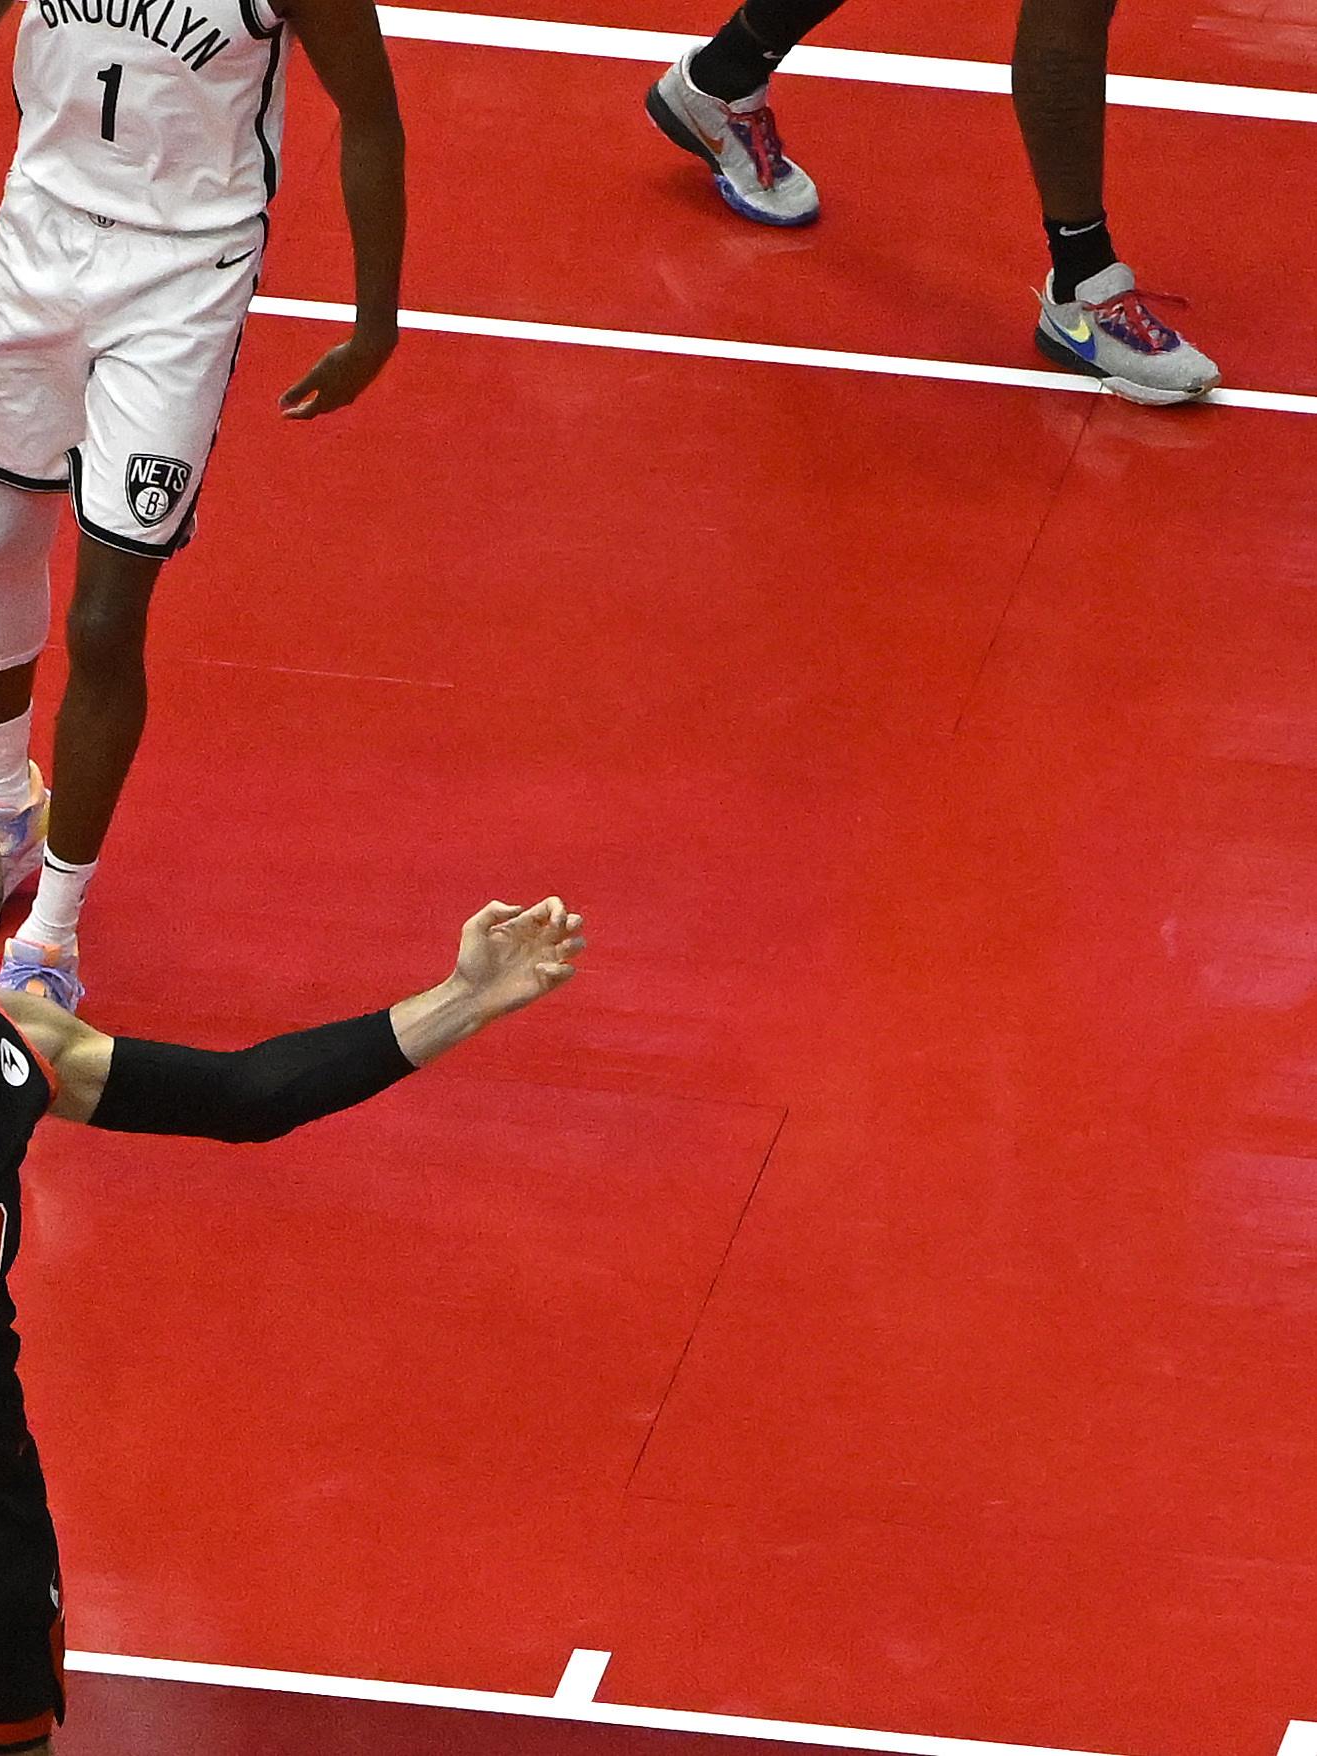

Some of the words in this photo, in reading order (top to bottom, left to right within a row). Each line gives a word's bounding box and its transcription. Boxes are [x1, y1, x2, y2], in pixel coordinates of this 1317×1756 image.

[96, 62, 123, 142] 1
[130, 459, 188, 493] NETS
[145, 491, 160, 516] B
